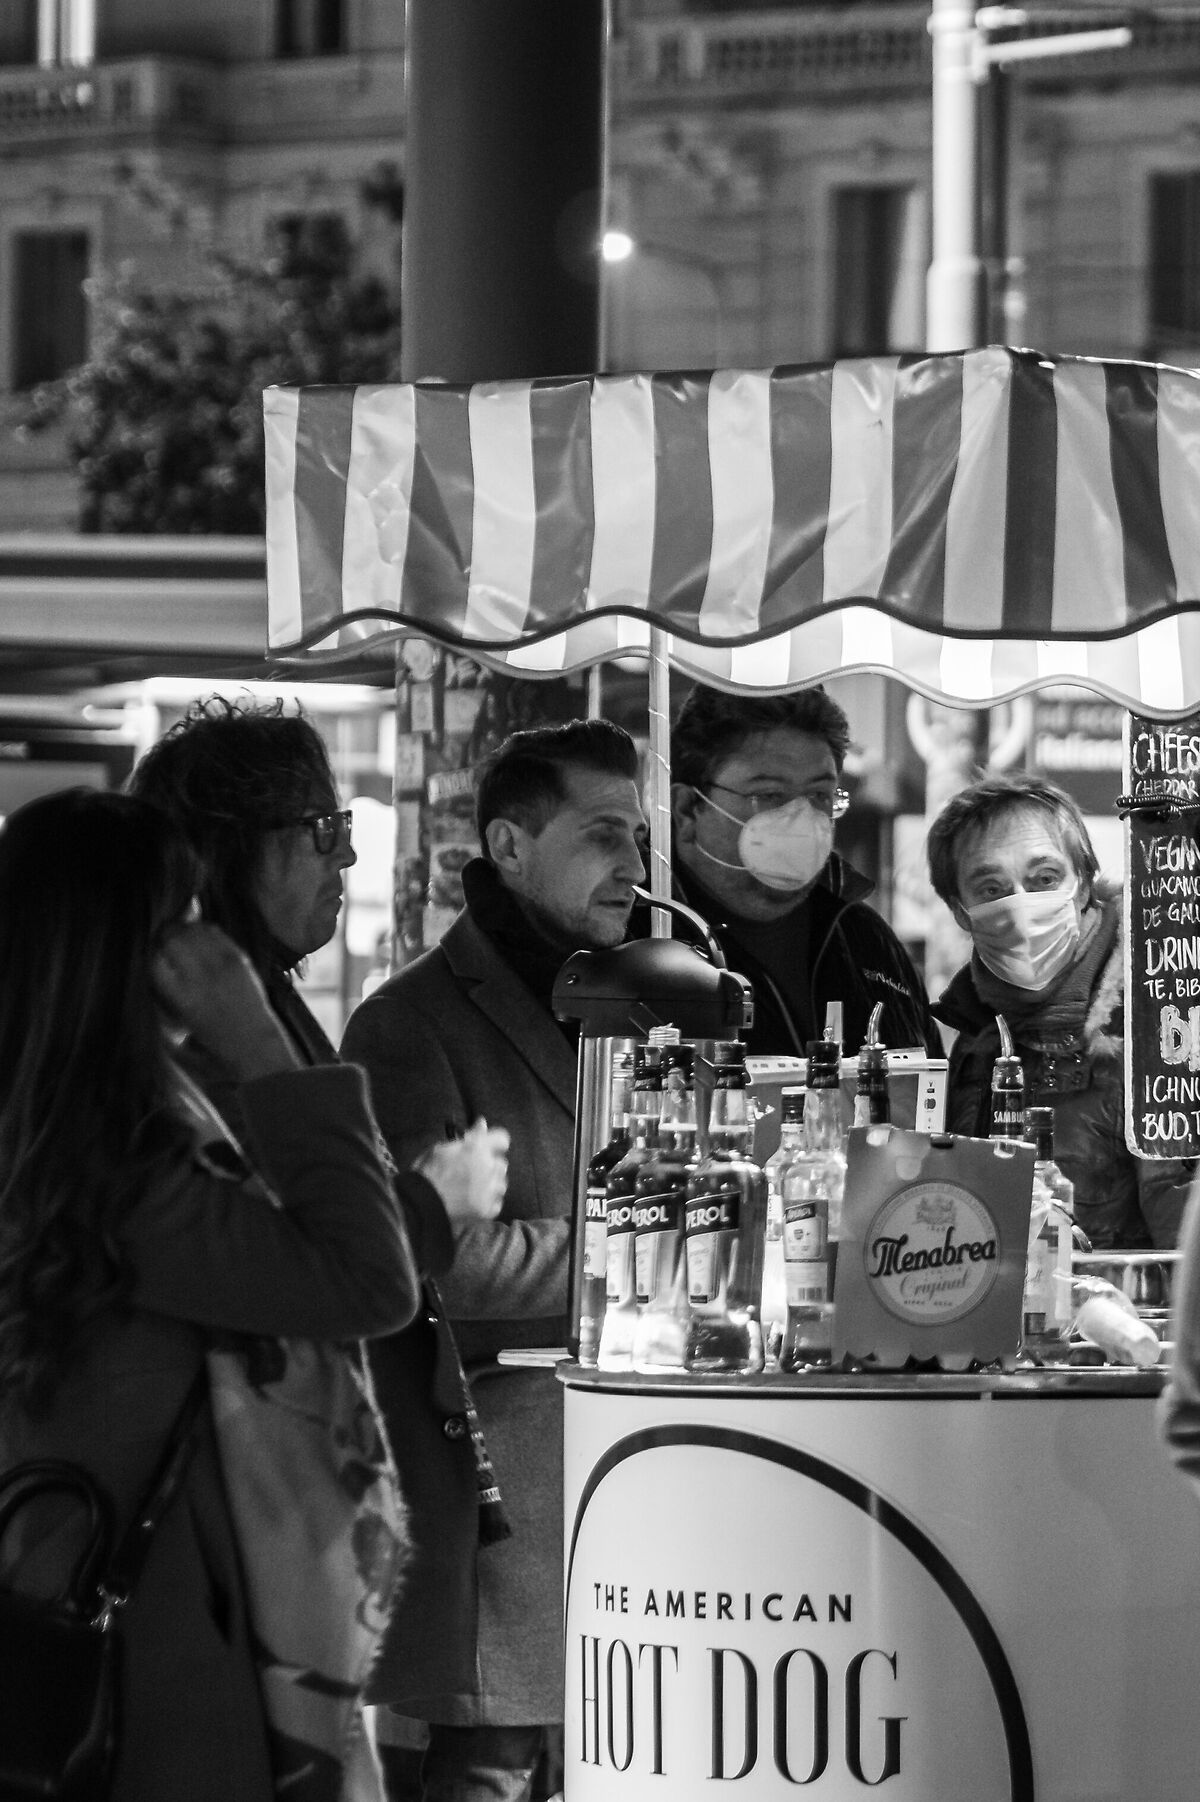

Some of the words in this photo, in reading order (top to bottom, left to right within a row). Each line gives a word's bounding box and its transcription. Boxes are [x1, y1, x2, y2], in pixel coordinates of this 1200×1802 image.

[1142, 904, 1162, 931] DE
[869, 1225, 997, 1279] Menabrea
[593, 1582, 630, 1614] THE
[643, 1588, 853, 1623] AMERICAN
[578, 1633, 680, 1777] HOT
[705, 1647, 909, 1787] DOG
